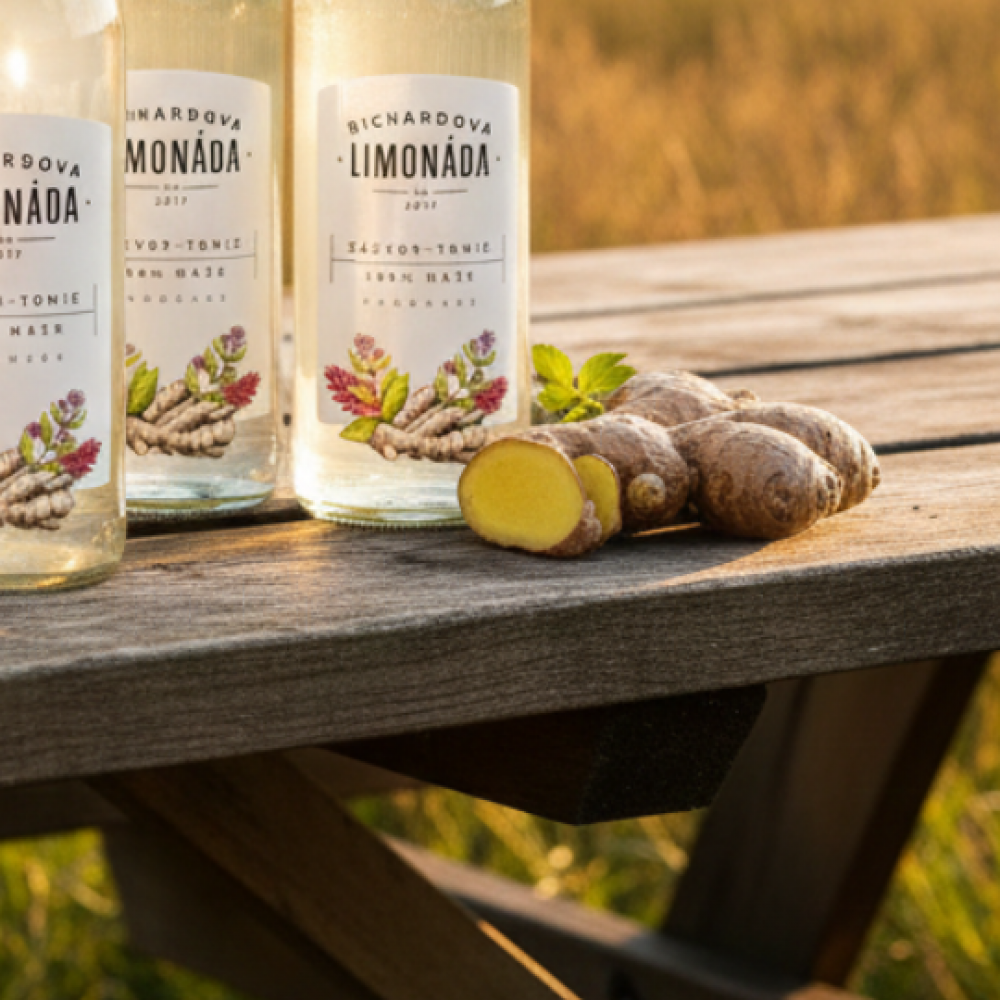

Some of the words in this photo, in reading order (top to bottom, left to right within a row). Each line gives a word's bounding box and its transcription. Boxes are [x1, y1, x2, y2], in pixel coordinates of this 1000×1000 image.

[126, 106, 242, 131] HARDOVA
[124, 129, 241, 174] MONÁDA
[350, 134, 490, 178] LIMONÁDA
